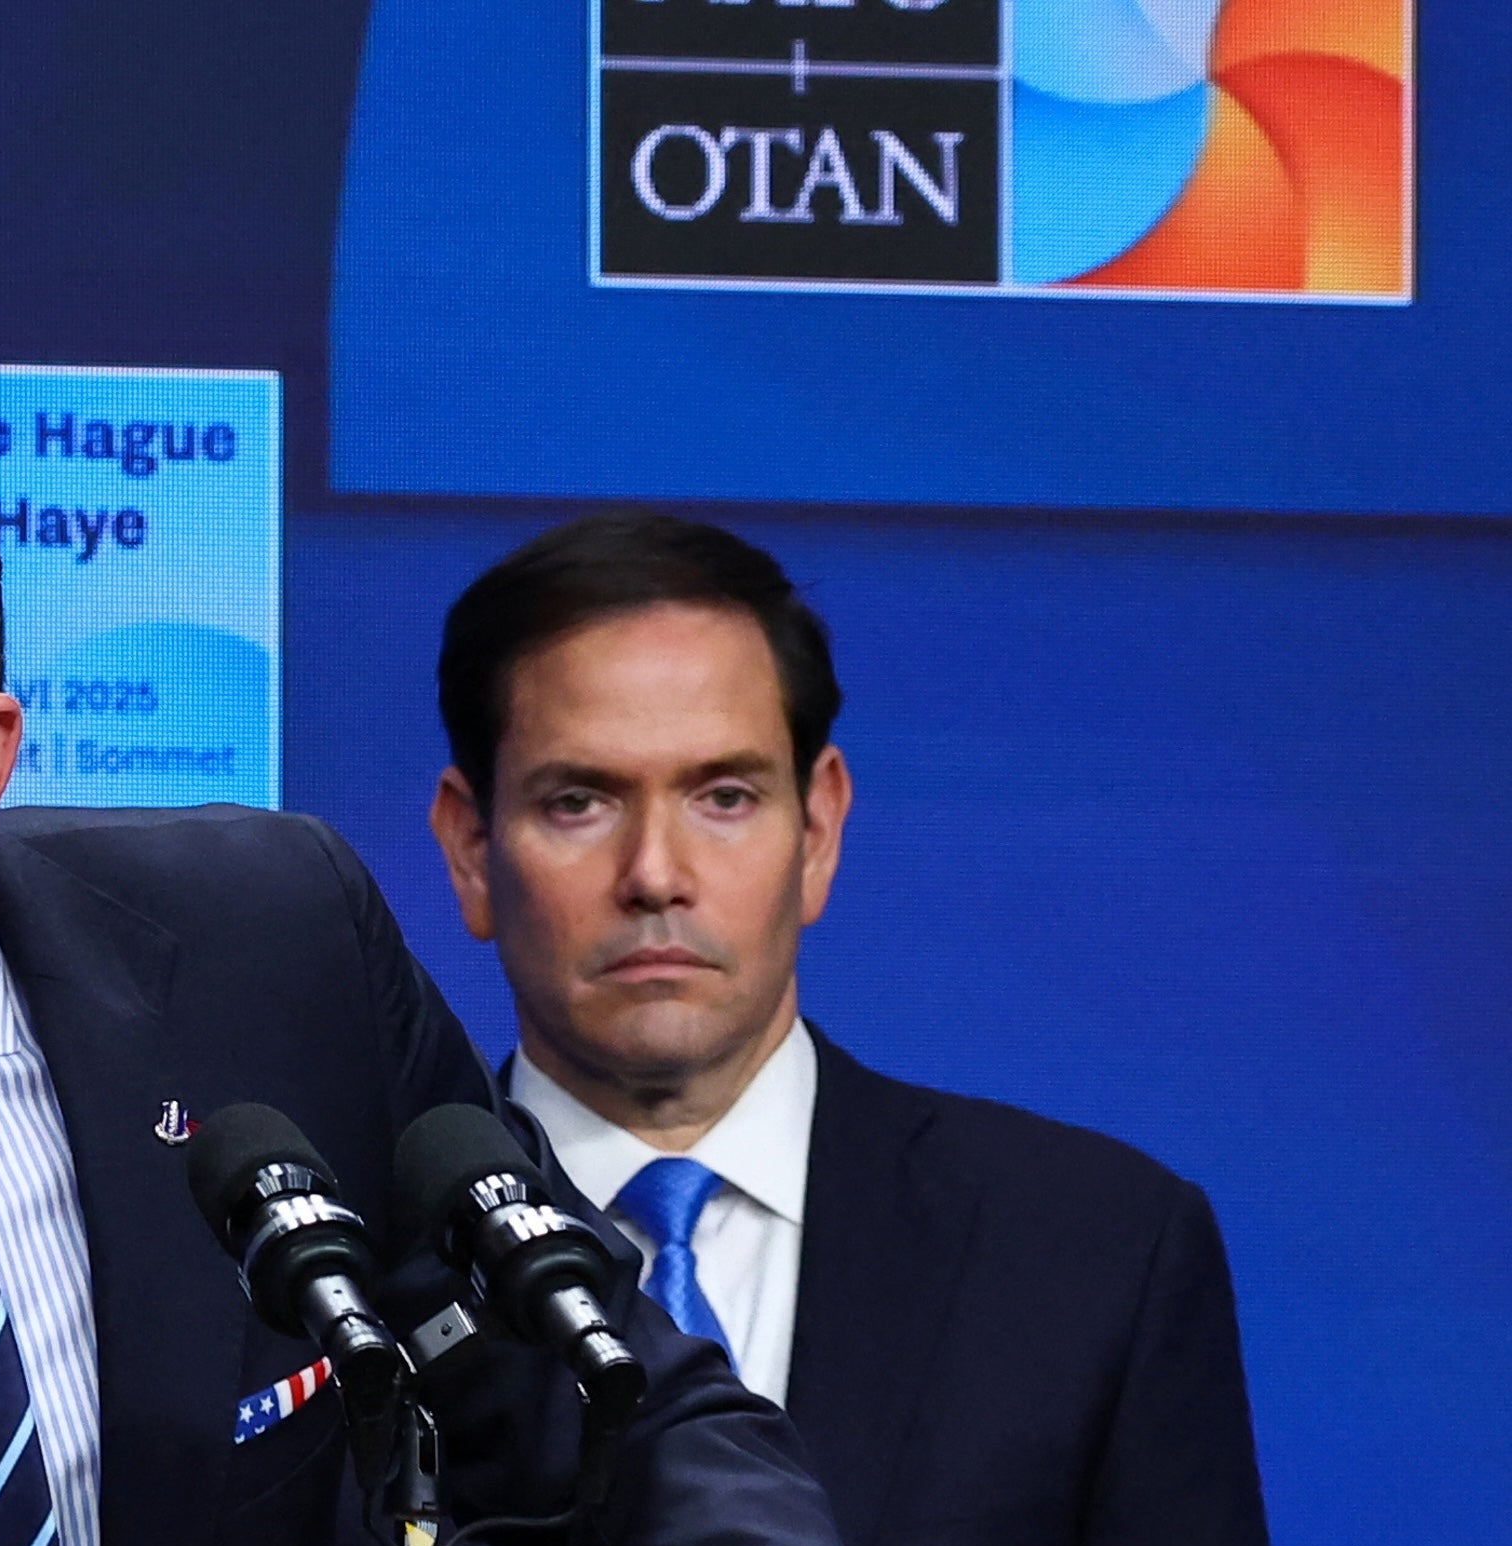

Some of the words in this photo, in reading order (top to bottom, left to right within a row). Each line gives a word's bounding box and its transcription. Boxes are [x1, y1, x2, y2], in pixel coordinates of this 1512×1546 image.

[630, 123, 965, 225] OTAN
[34, 412, 236, 479] Hague
[65, 680, 159, 711] 2025
